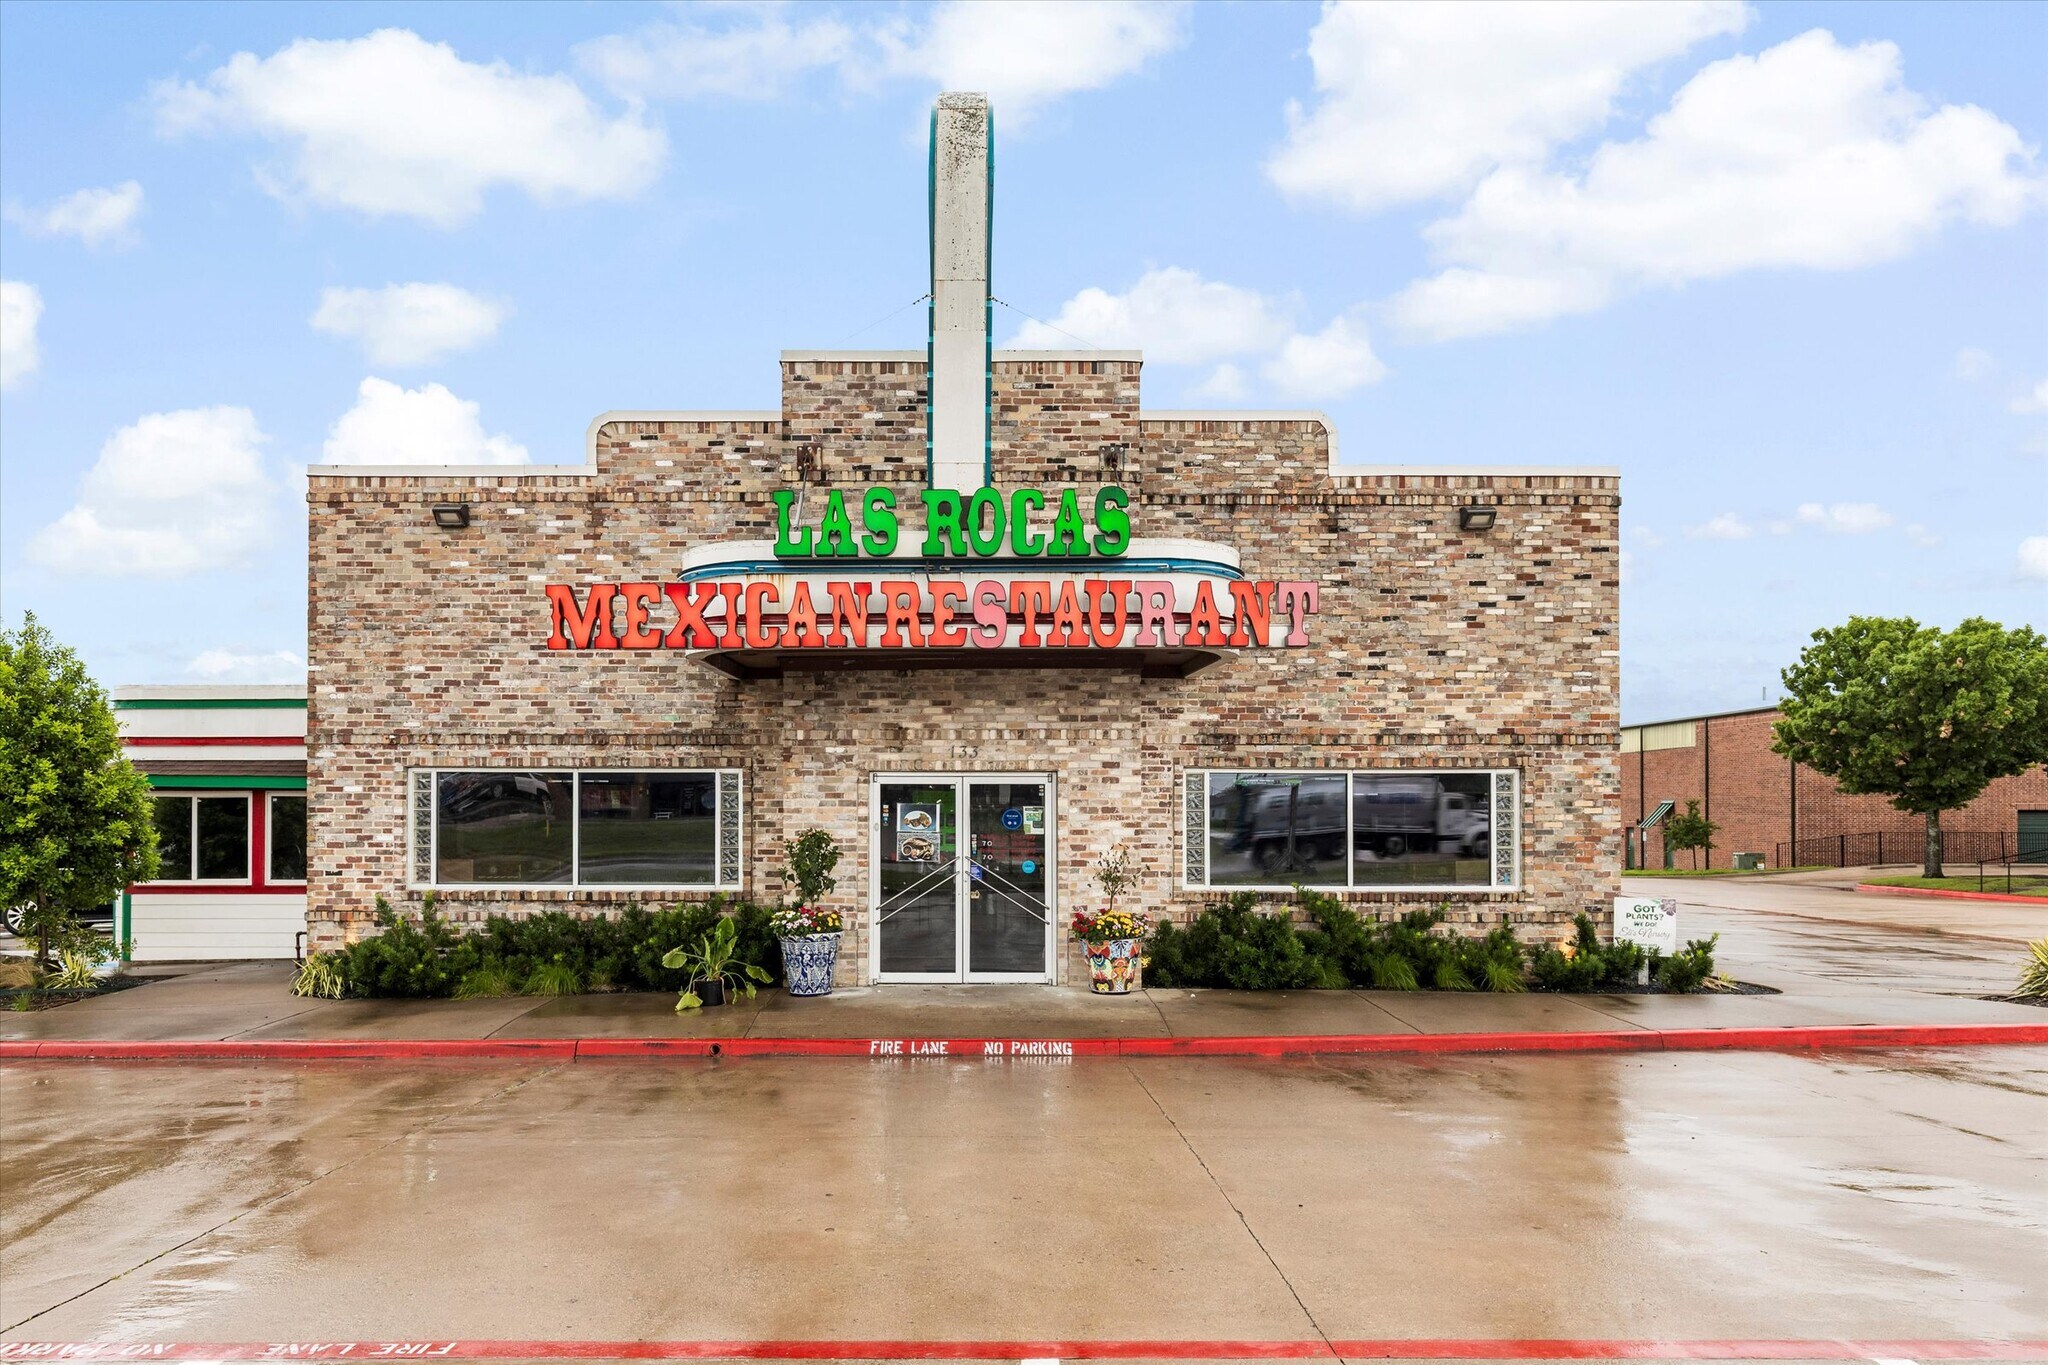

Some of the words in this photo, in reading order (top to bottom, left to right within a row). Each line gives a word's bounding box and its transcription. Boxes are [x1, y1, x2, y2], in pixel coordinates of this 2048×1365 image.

[773, 486, 899, 558] LAS
[921, 486, 1131, 558] ROCAS
[545, 581, 873, 650] MEXICAN
[879, 579, 1320, 650] RESTAURANT
[949, 744, 979, 759] 133
[1633, 904, 1656, 912] GOT
[1626, 912, 1664, 921] PLANTS?
[870, 1040, 904, 1055] FIRE
[911, 1040, 949, 1055] LANE
[984, 1041, 1004, 1056] NO
[1011, 1041, 1073, 1056] PARKING
[255, 1342, 358, 1356] LANE
[369, 1342, 457, 1355] FIRE
